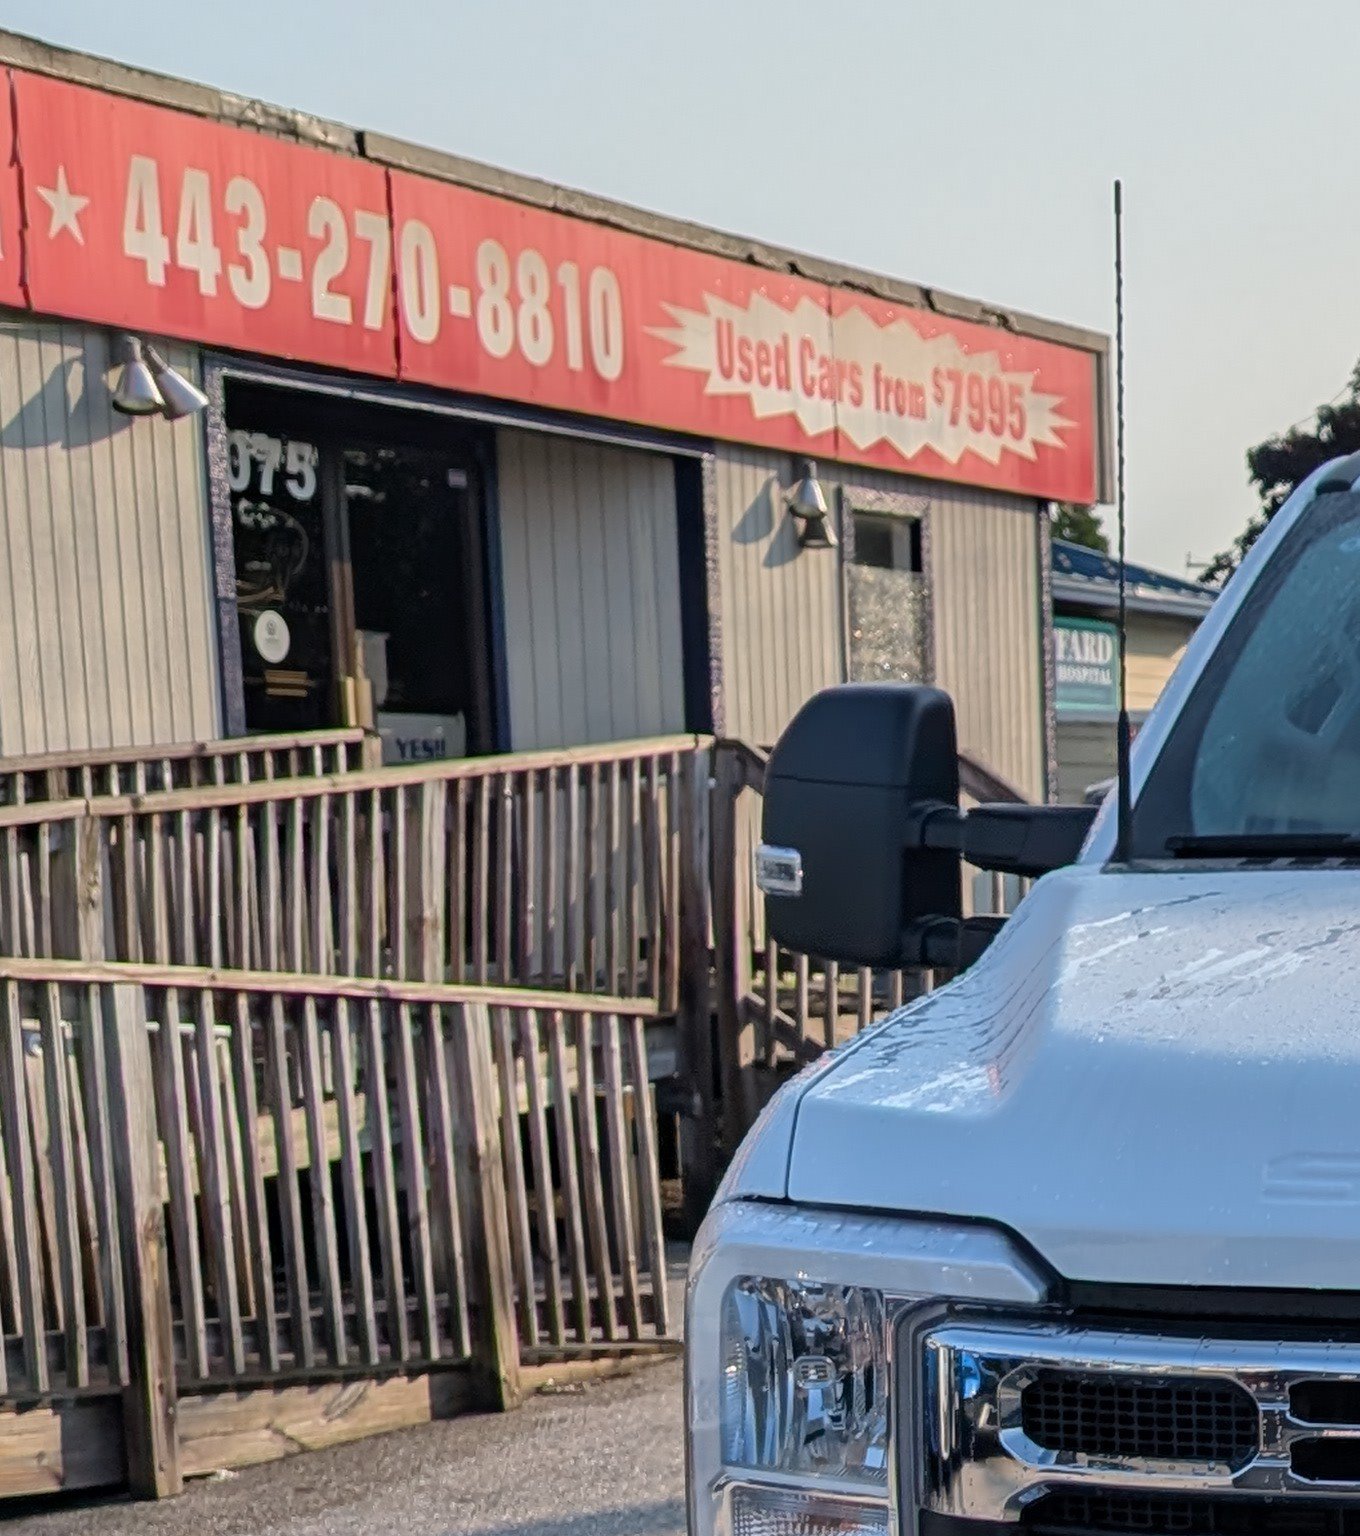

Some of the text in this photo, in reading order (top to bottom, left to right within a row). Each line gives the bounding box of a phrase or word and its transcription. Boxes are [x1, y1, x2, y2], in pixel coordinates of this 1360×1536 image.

[123, 155, 623, 381] 443-270-8810
[716, 318, 1026, 440] Used Cars from $7995
